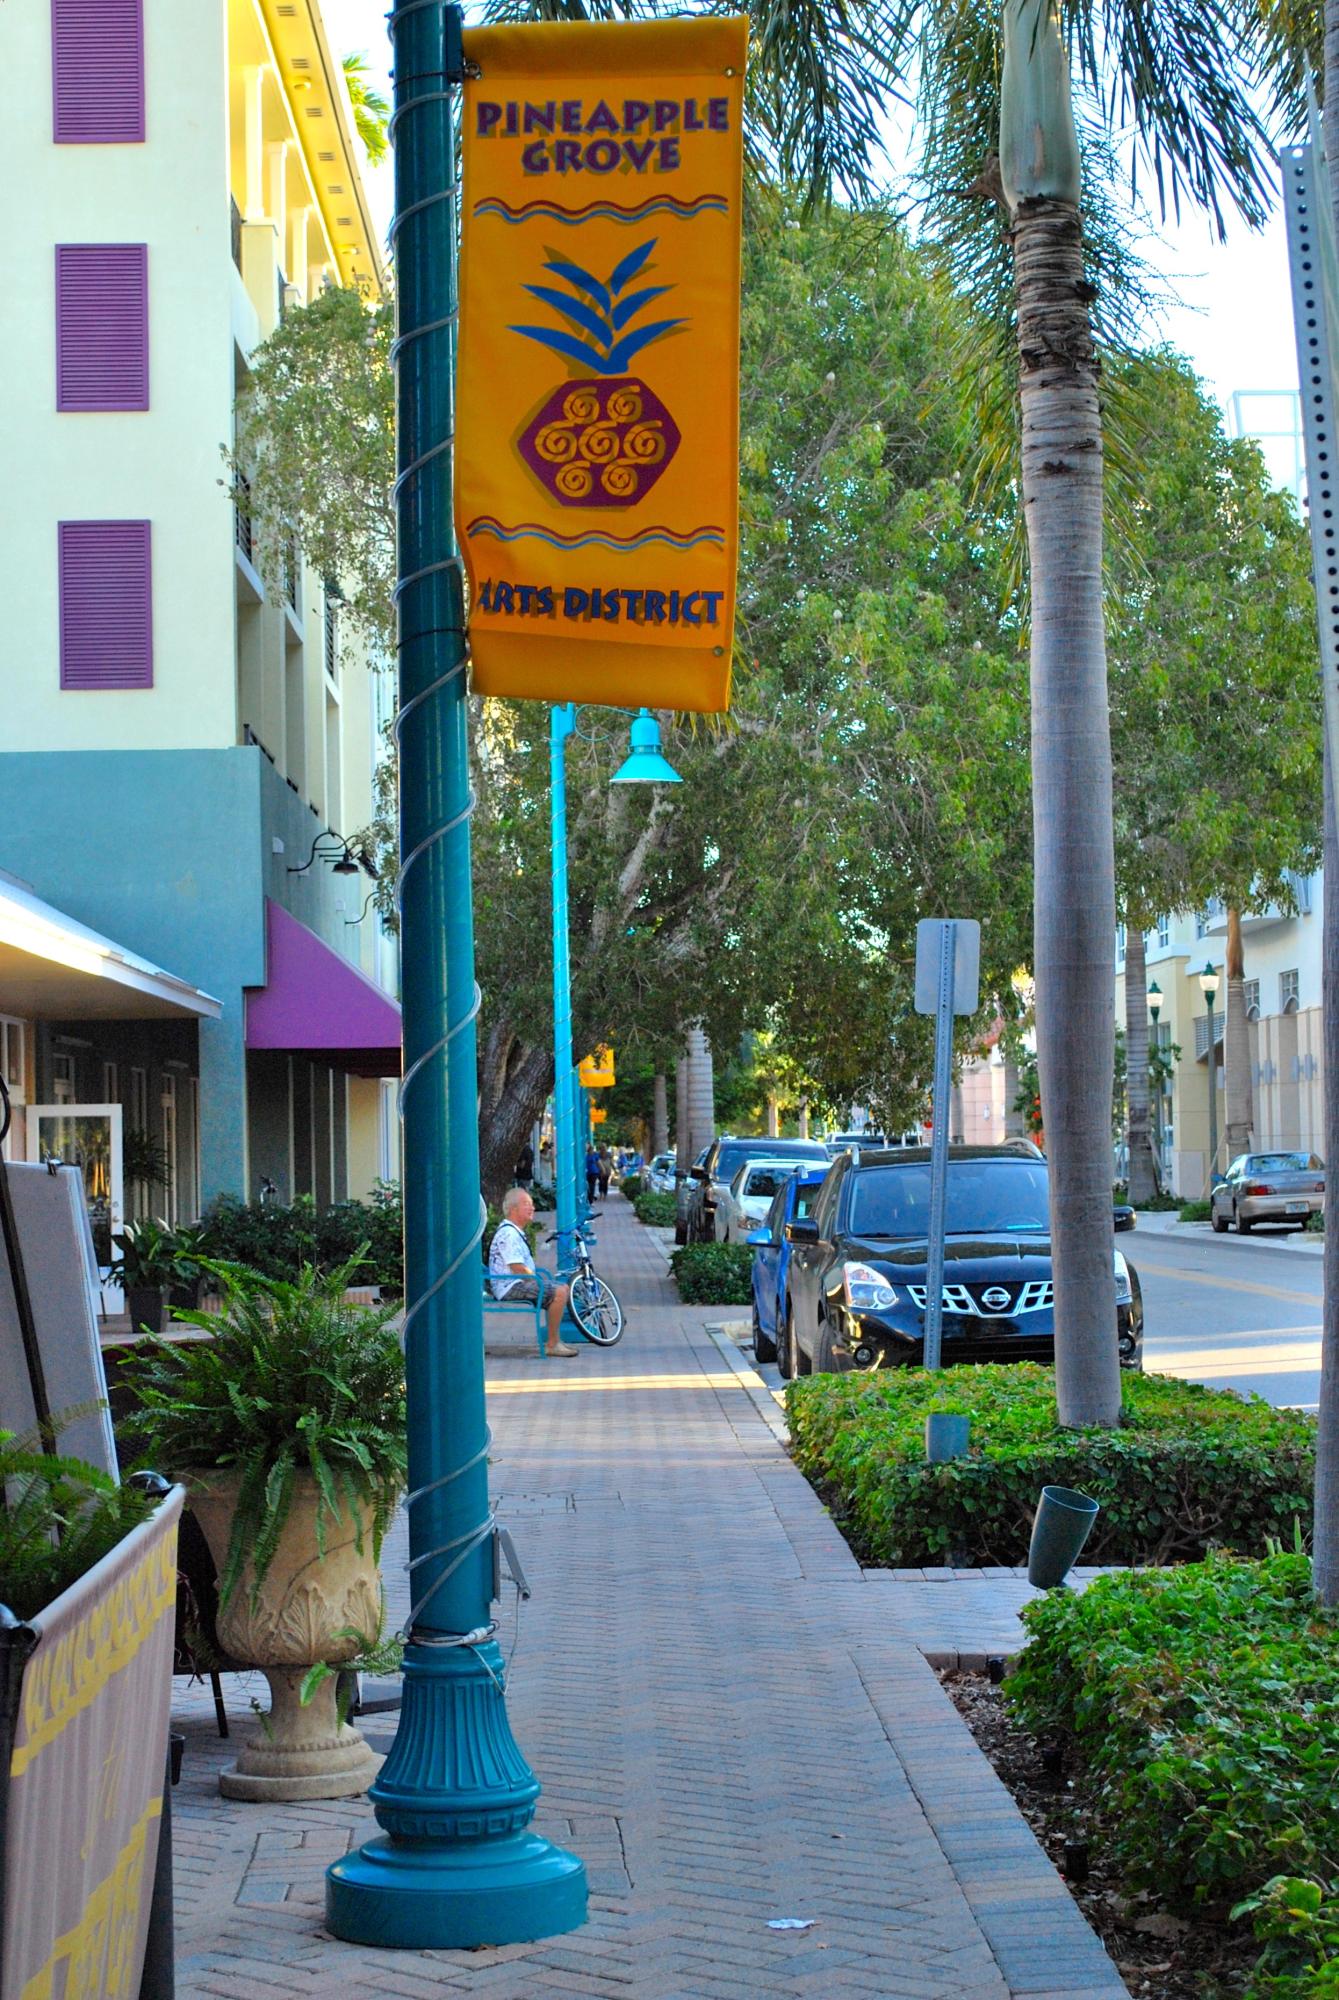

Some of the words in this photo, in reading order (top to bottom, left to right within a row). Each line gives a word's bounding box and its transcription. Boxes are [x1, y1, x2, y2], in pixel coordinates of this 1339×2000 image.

[476, 97, 729, 134] PINEAPPLE
[521, 137, 681, 173] GROVE
[564, 587, 724, 624] DISTRICT
